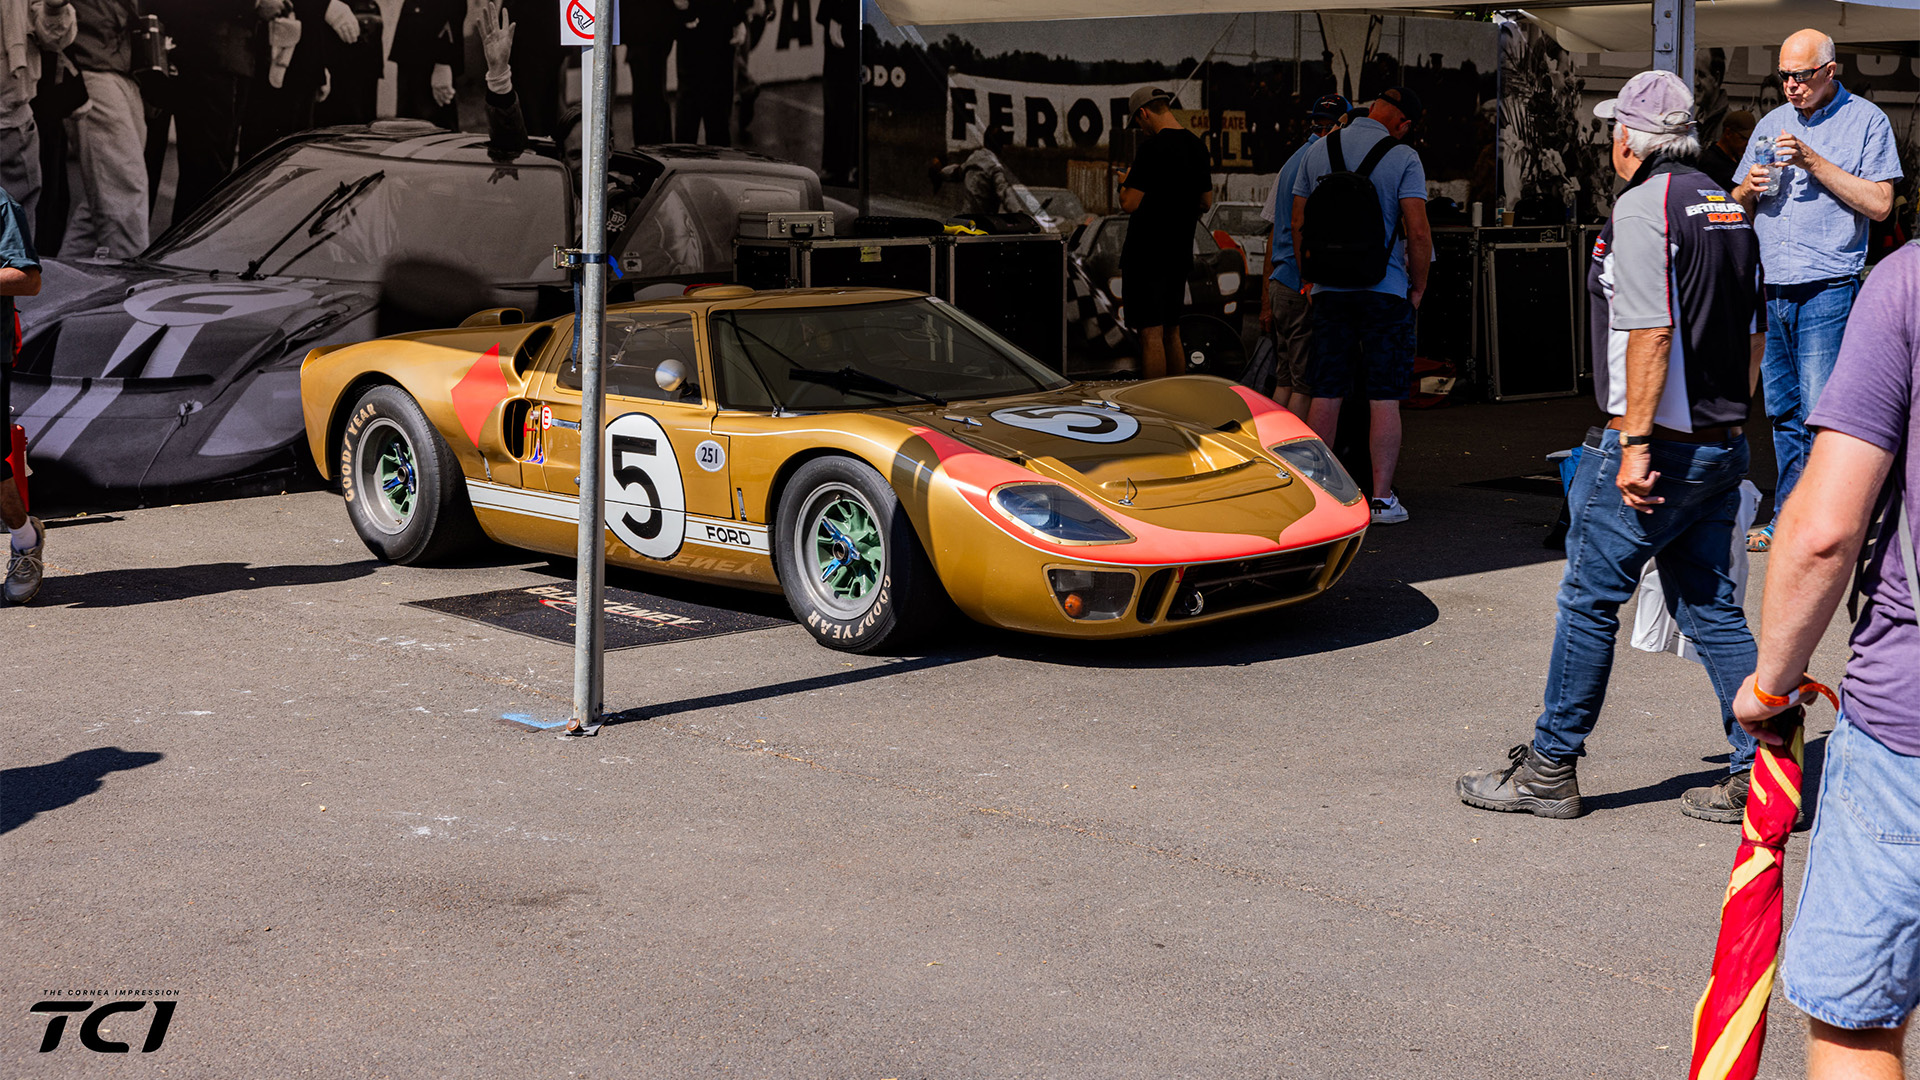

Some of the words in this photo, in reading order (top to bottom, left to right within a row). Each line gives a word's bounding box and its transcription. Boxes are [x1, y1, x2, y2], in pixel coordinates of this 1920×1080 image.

[951, 87, 1182, 150] FERO
[1707, 212, 1743, 222] 1000
[542, 409, 551, 427] E
[1006, 405, 1119, 435] 5
[701, 446, 718, 464] 251
[611, 433, 663, 541] 5
[705, 525, 751, 546] FORD
